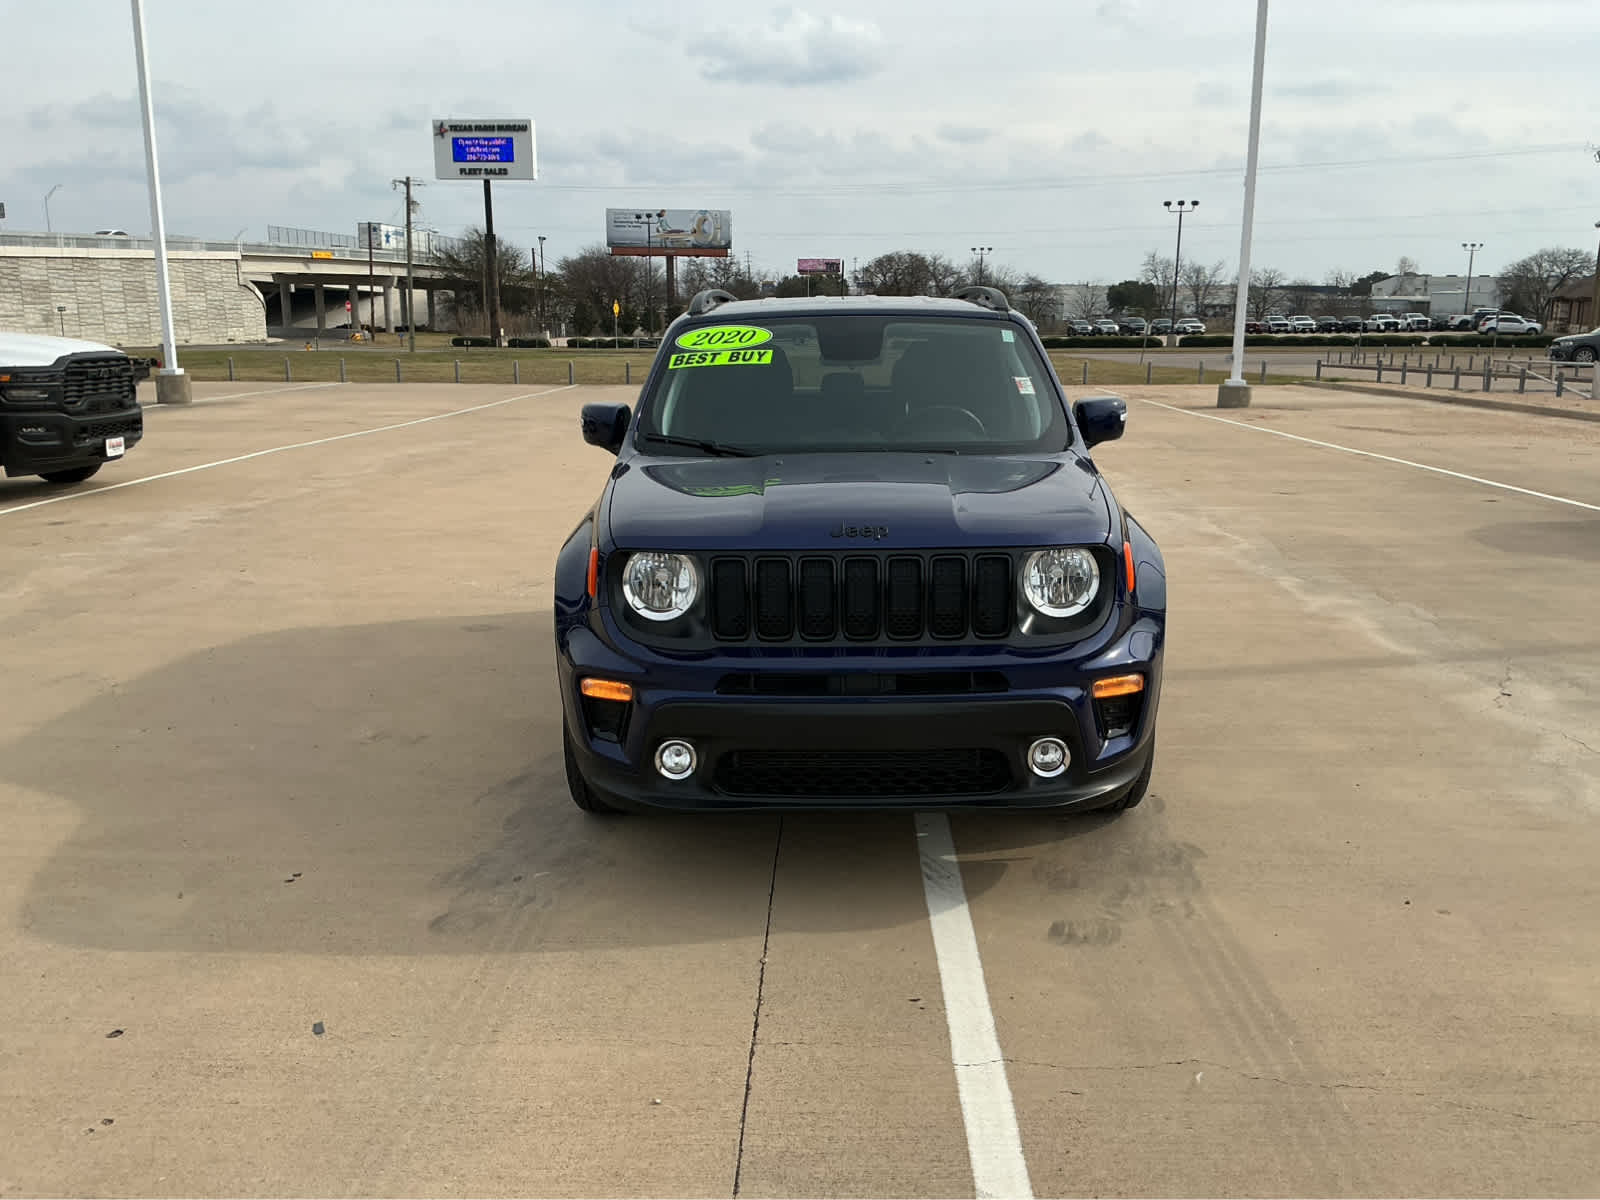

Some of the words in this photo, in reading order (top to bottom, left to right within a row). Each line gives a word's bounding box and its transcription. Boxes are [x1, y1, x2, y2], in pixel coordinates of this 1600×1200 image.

[448, 124, 473, 132] TEXAS
[474, 124, 496, 132] FARM
[497, 124, 528, 132] BUREAU
[459, 167, 482, 176] FLEET
[483, 167, 508, 176] SALES
[690, 330, 757, 346] 2020
[672, 352, 721, 367] BEST
[727, 350, 768, 363] BUY
[830, 519, 889, 541] Jeep
